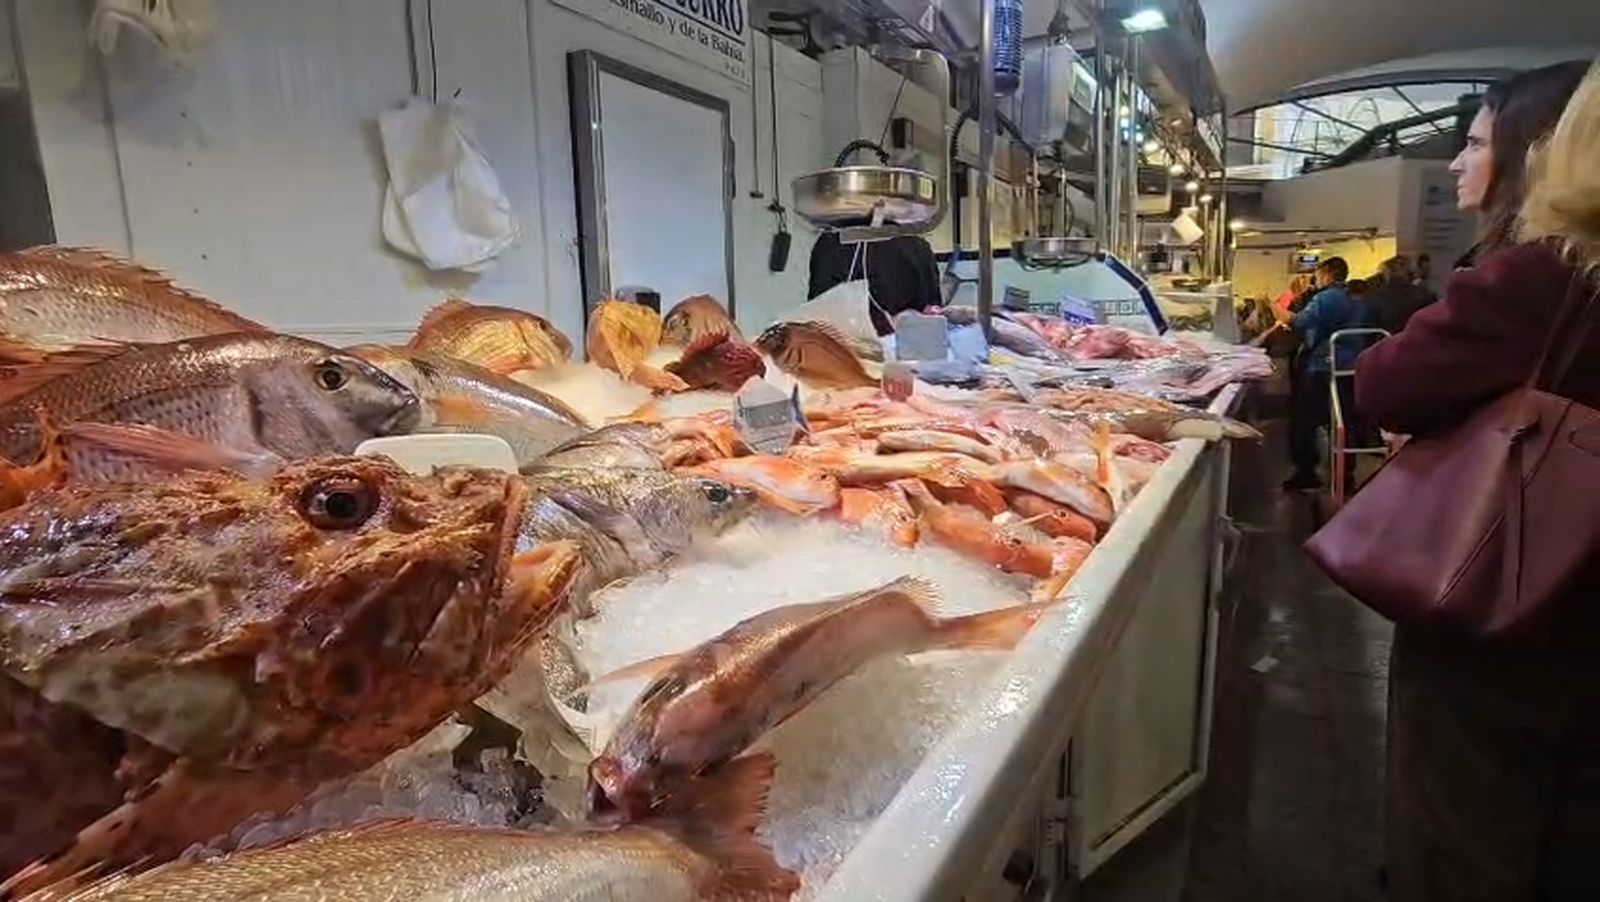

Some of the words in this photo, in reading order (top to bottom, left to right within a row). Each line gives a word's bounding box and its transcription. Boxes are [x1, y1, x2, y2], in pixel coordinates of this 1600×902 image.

[667, 16, 676, 35] y
[679, 20, 695, 40] de
[698, 27, 708, 46] la
